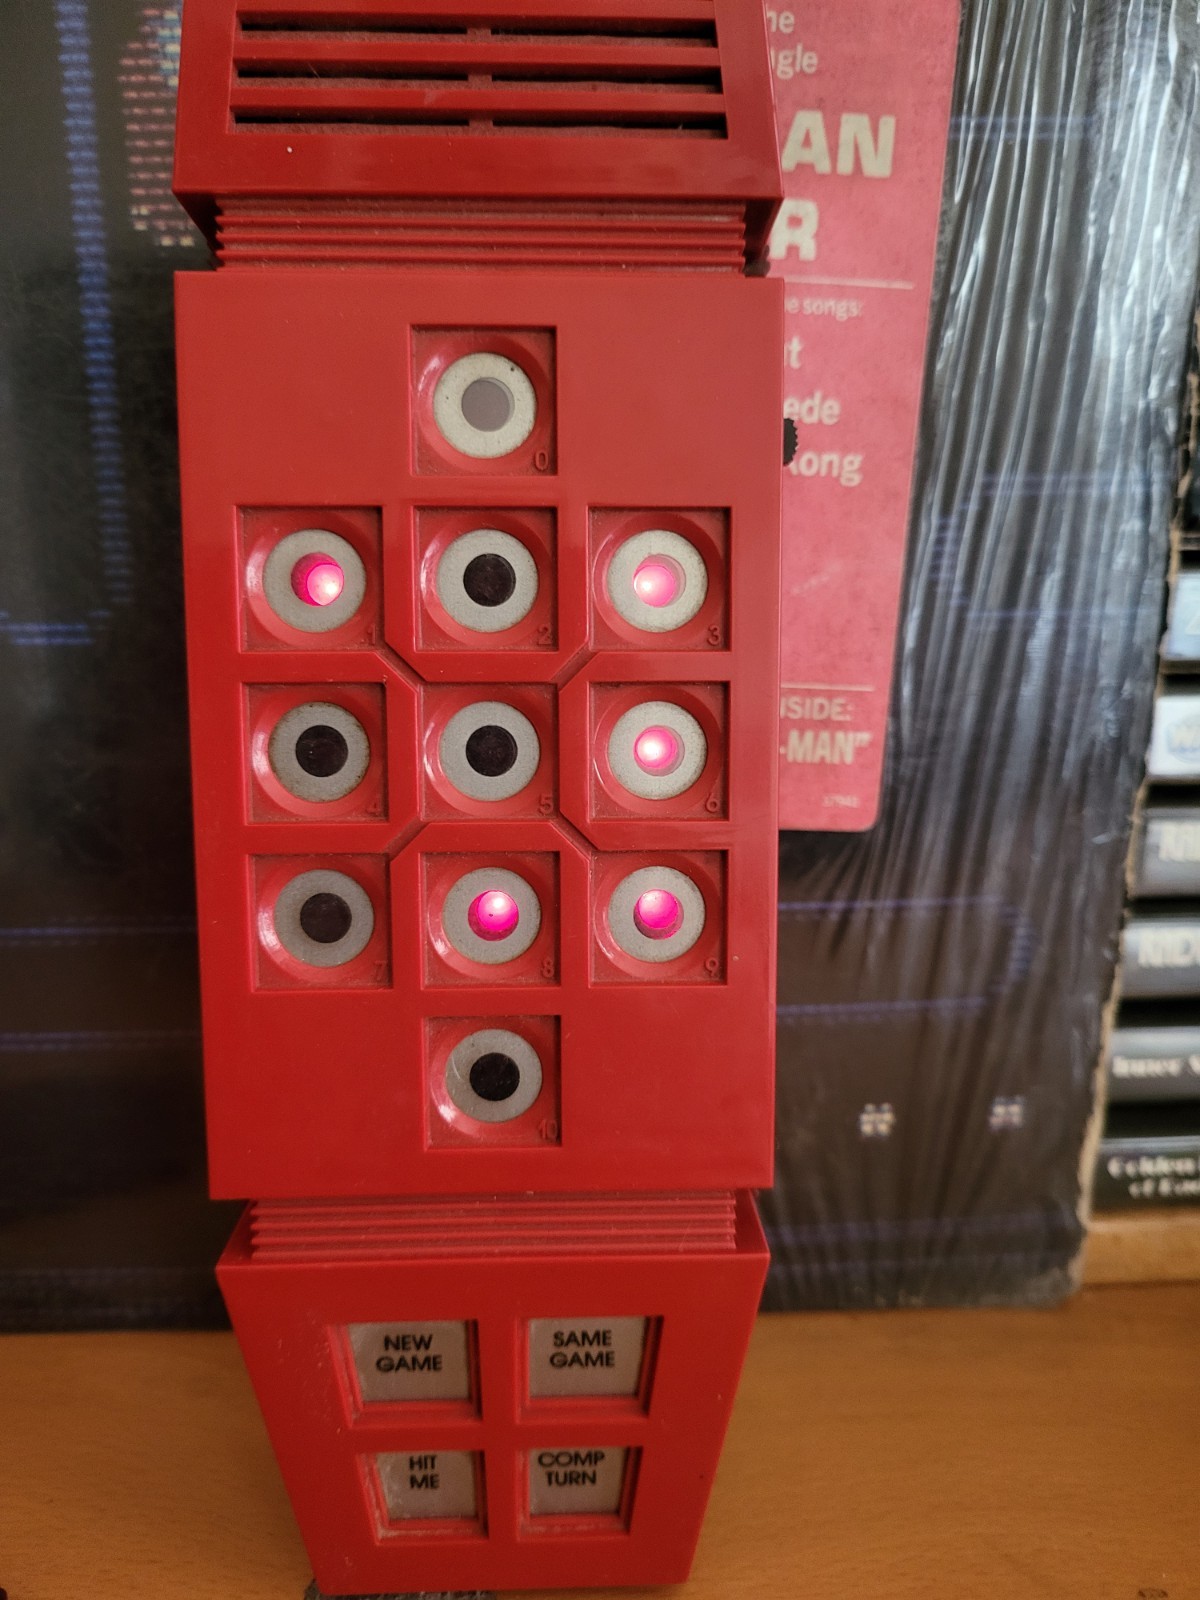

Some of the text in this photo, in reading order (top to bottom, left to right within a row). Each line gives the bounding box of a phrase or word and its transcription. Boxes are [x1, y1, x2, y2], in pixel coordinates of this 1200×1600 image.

[533, 449, 549, 471] 0
[536, 623, 552, 646] 2
[706, 624, 721, 646] 3
[537, 794, 554, 816] 5
[705, 793, 720, 815] 6
[704, 957, 720, 977] 9
[383, 1334, 433, 1351] NEW
[553, 1329, 612, 1347] SAME
[376, 1354, 442, 1372] GAME
[549, 1350, 615, 1368] GAME
[408, 1454, 437, 1471] HIT
[537, 1450, 605, 1467] COMP
[410, 1473, 440, 1490] ME
[545, 1470, 597, 1487] TURN
